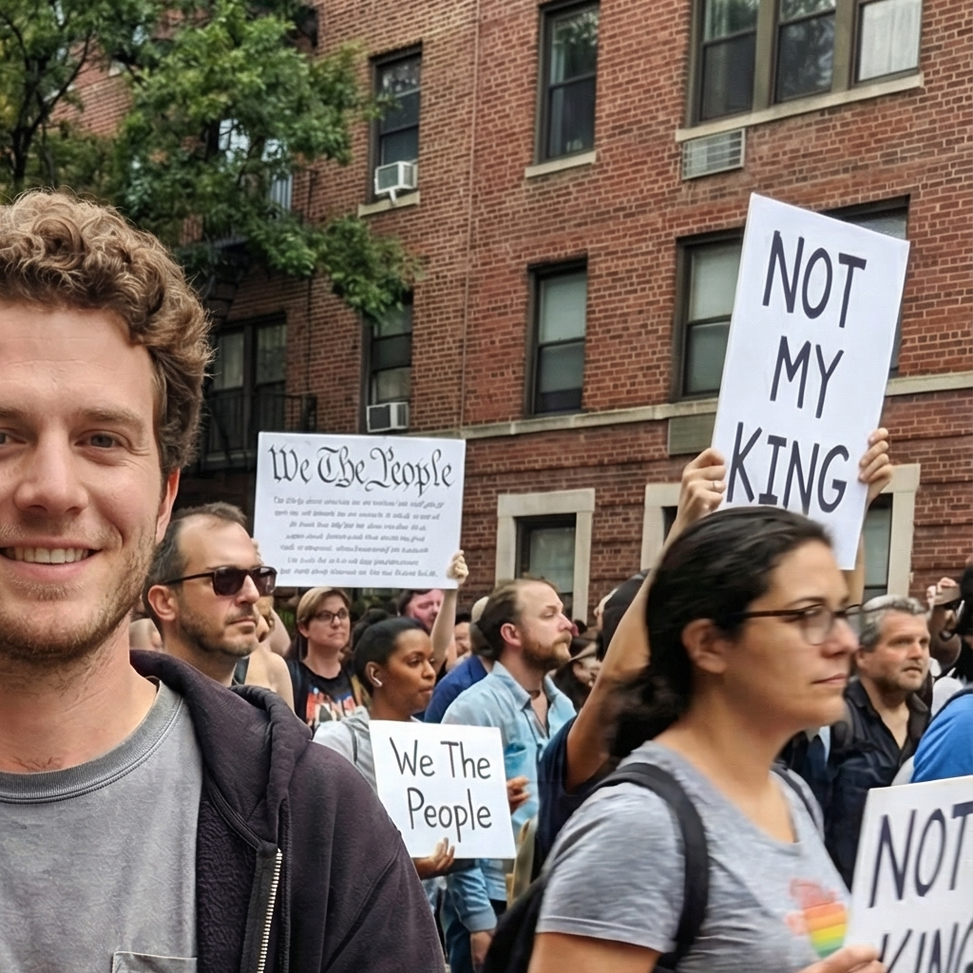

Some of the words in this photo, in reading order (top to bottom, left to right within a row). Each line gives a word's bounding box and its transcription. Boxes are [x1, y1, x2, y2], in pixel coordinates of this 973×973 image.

[762, 229, 867, 329] NOT
[769, 335, 845, 419] MY
[268, 444, 312, 484] We
[317, 445, 366, 488] The
[364, 446, 455, 498] People
[726, 421, 850, 515] KING
[389, 736, 435, 777] We
[440, 740, 491, 779] The
[407, 786, 493, 843] People
[868, 801, 973, 909] NOT
